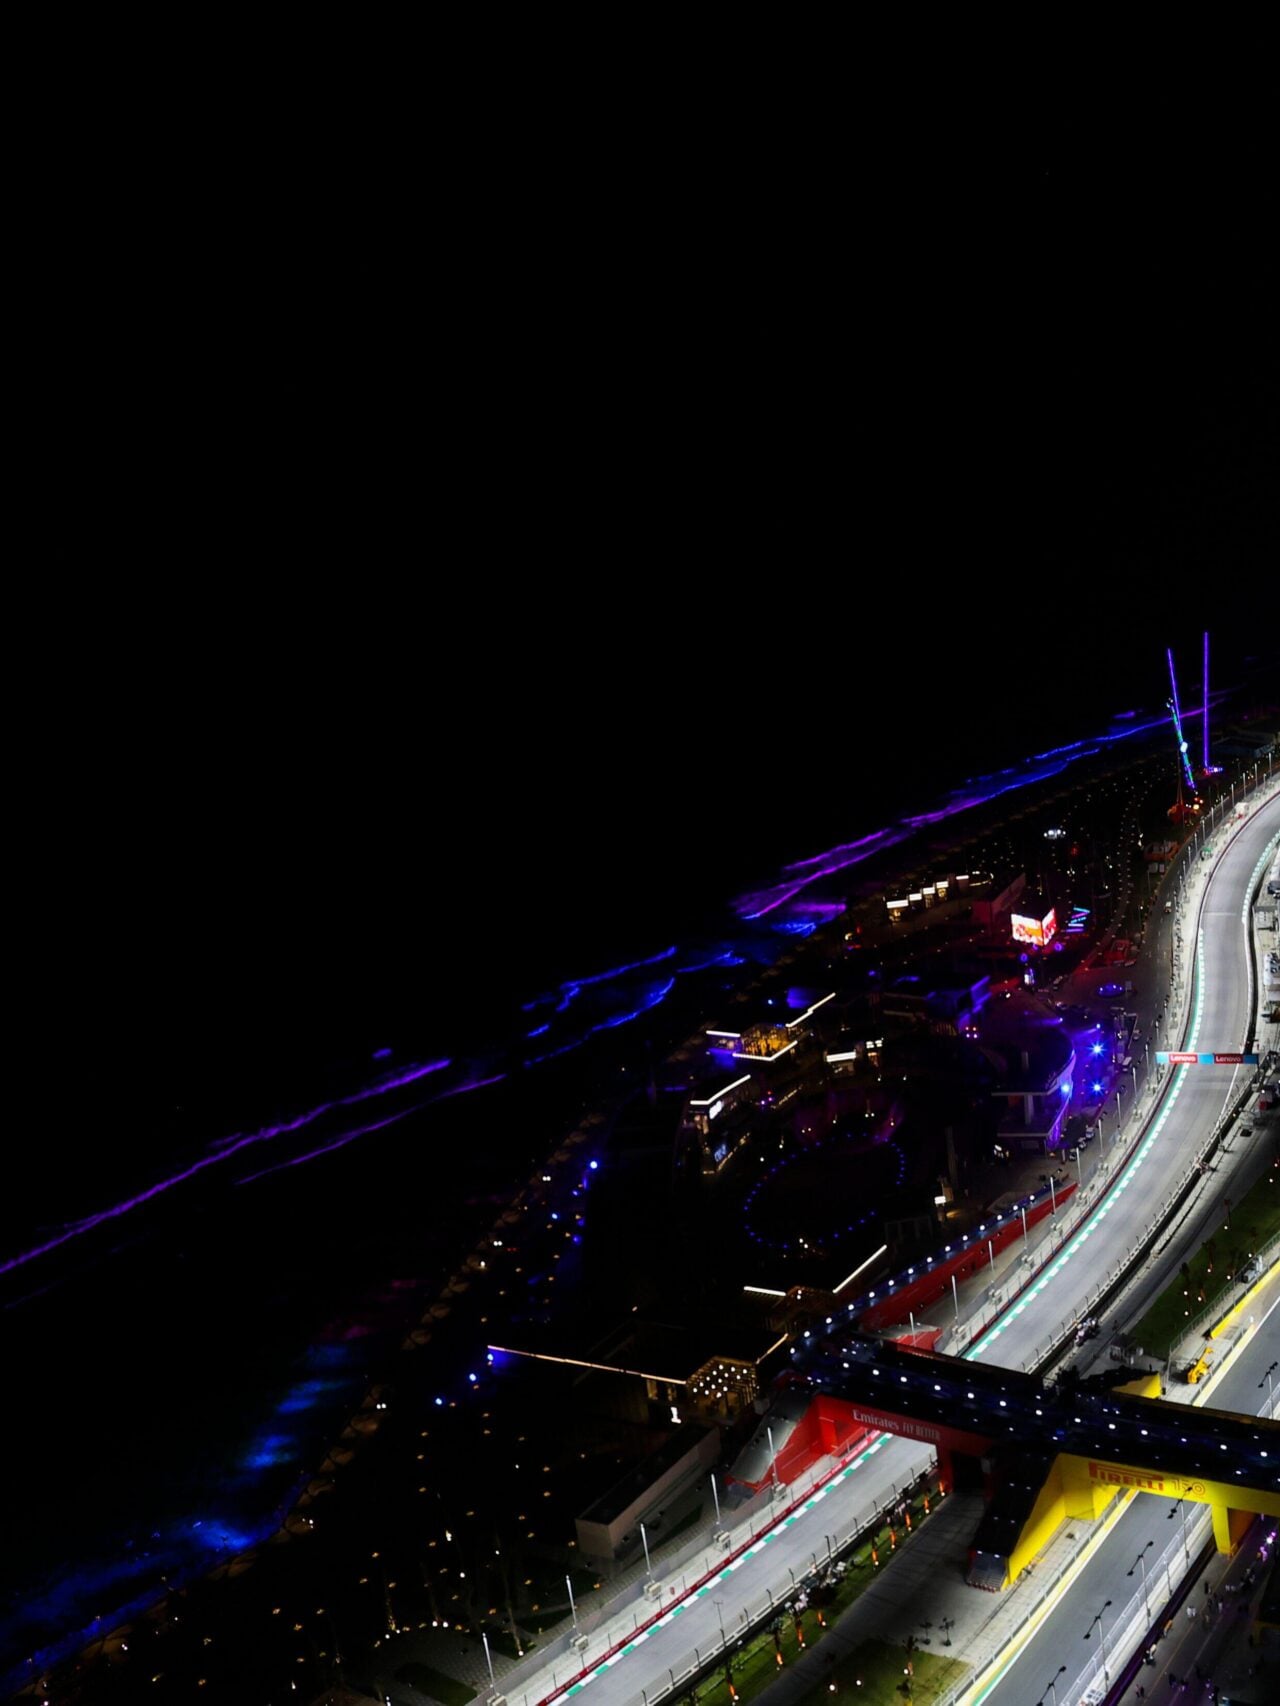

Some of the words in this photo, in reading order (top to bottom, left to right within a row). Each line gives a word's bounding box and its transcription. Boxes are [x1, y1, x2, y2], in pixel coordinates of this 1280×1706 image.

[1171, 1054, 1196, 1062] Lenovo
[1216, 1054, 1241, 1062] Lenovo
[853, 1410, 899, 1430] Emirates
[1089, 1462, 1164, 1491] PIRELLI
